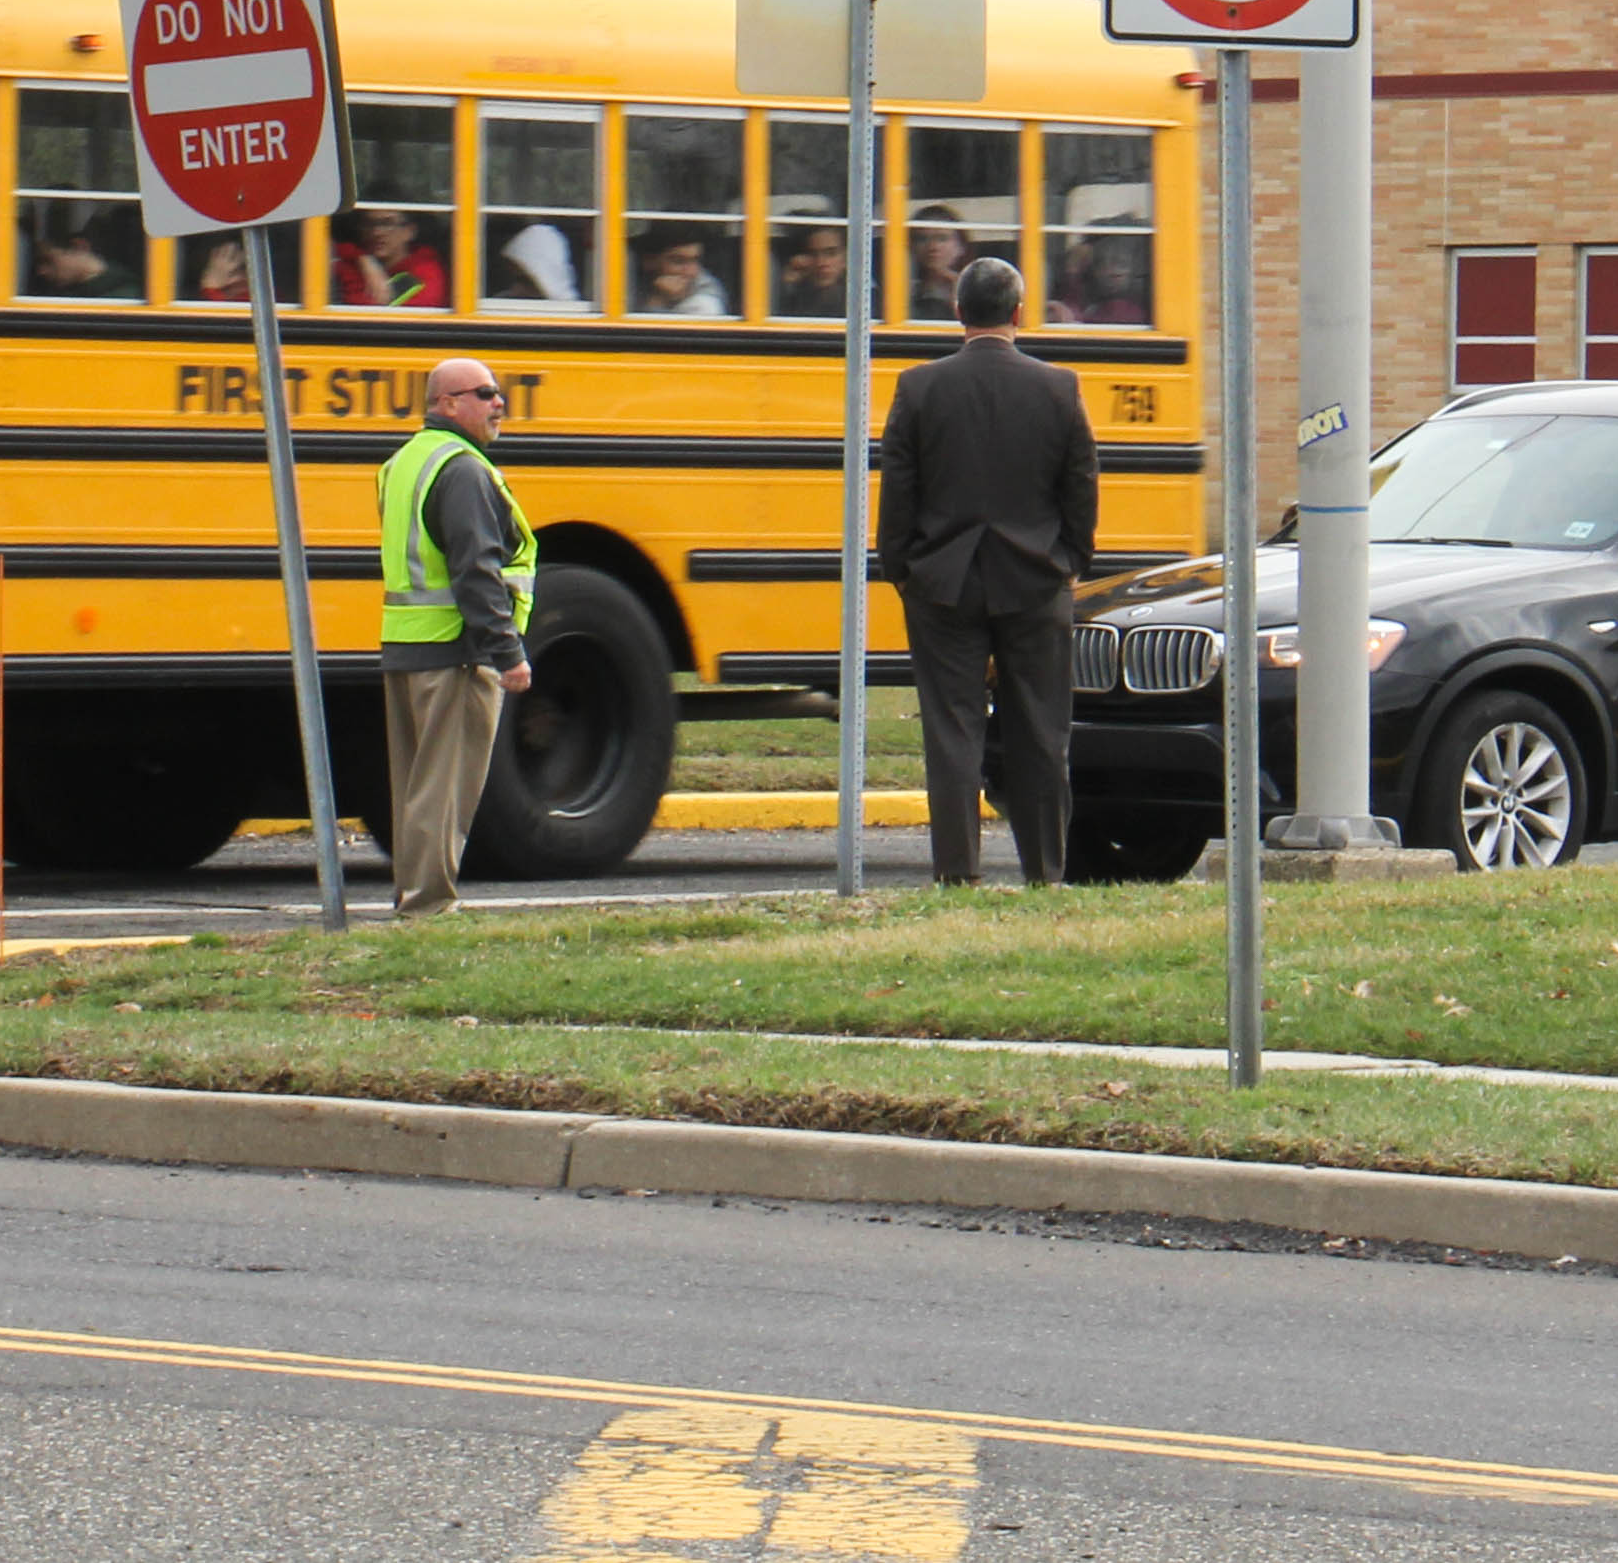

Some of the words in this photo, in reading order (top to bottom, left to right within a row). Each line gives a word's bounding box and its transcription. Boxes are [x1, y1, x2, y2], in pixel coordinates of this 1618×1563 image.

[154, 0, 202, 45] DO
[180, 119, 288, 171] ENTER
[1110, 384, 1159, 423] 759
